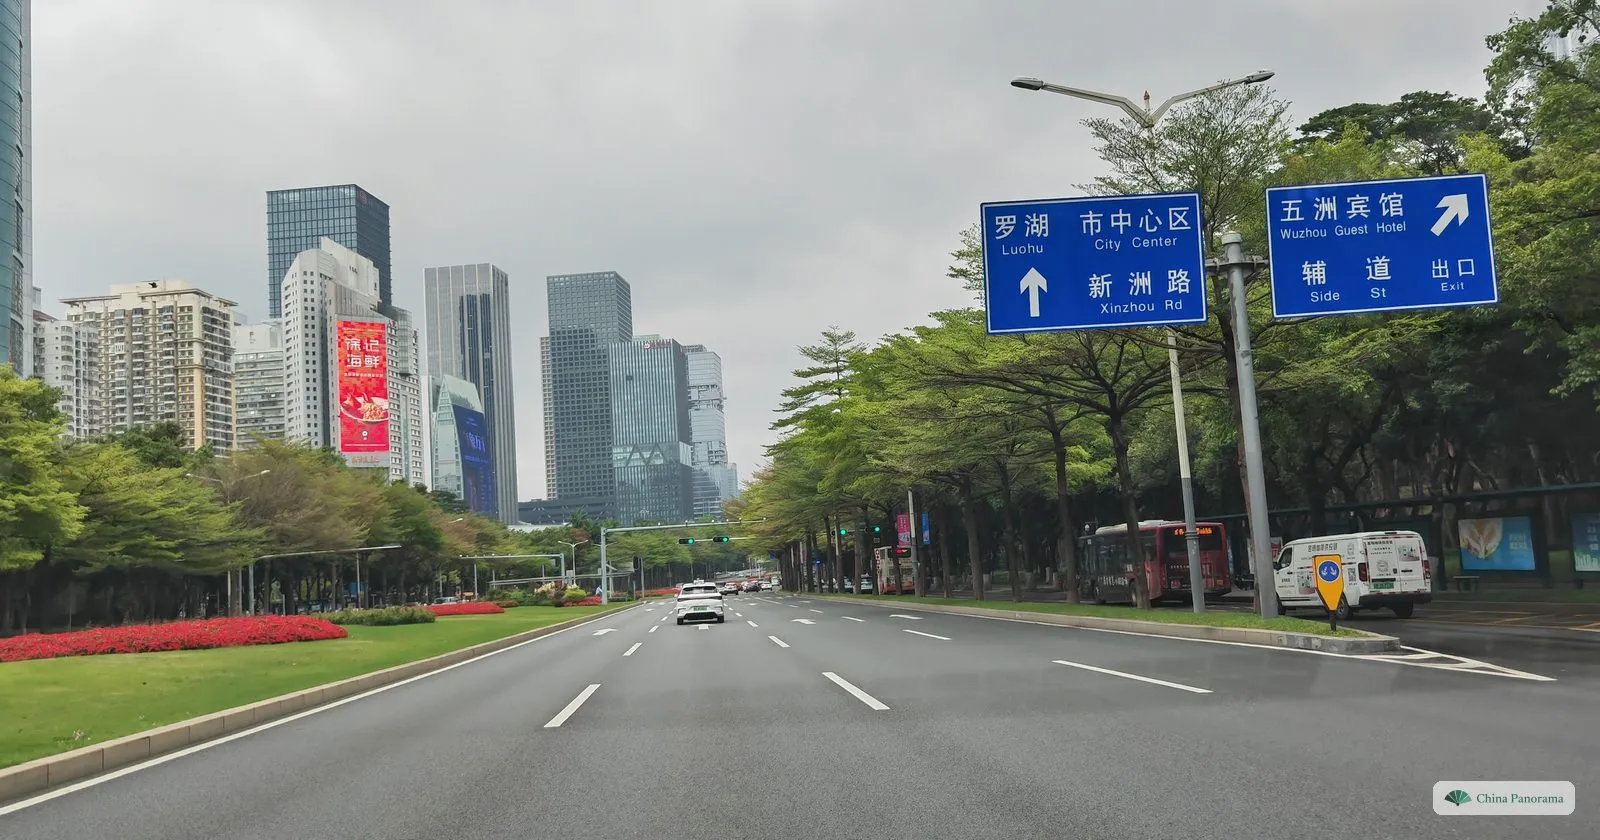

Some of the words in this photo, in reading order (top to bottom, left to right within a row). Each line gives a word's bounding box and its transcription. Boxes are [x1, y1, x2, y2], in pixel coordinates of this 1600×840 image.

[1280, 192, 1404, 222] 五洲宾馆
[995, 213, 1049, 240] 罗湖
[1080, 206, 1191, 236] 市中心区
[1280, 227, 1327, 240] Wuzhou
[1335, 225, 1368, 237] Guest
[1376, 221, 1406, 233] Hotel
[1002, 243, 1043, 255] Luohu
[1095, 238, 1121, 252] City
[1132, 236, 1178, 248] Center
[1302, 255, 1392, 286] 辅道
[1432, 258, 1475, 280] 出口
[1088, 269, 1191, 299] 新洲路
[1441, 282, 1465, 291] Exit
[1310, 290, 1340, 303] Side
[1370, 287, 1387, 298] St
[1100, 302, 1155, 314] Xinzhou
[1165, 300, 1183, 311] Rd
[346, 354, 380, 368] 海鲜
